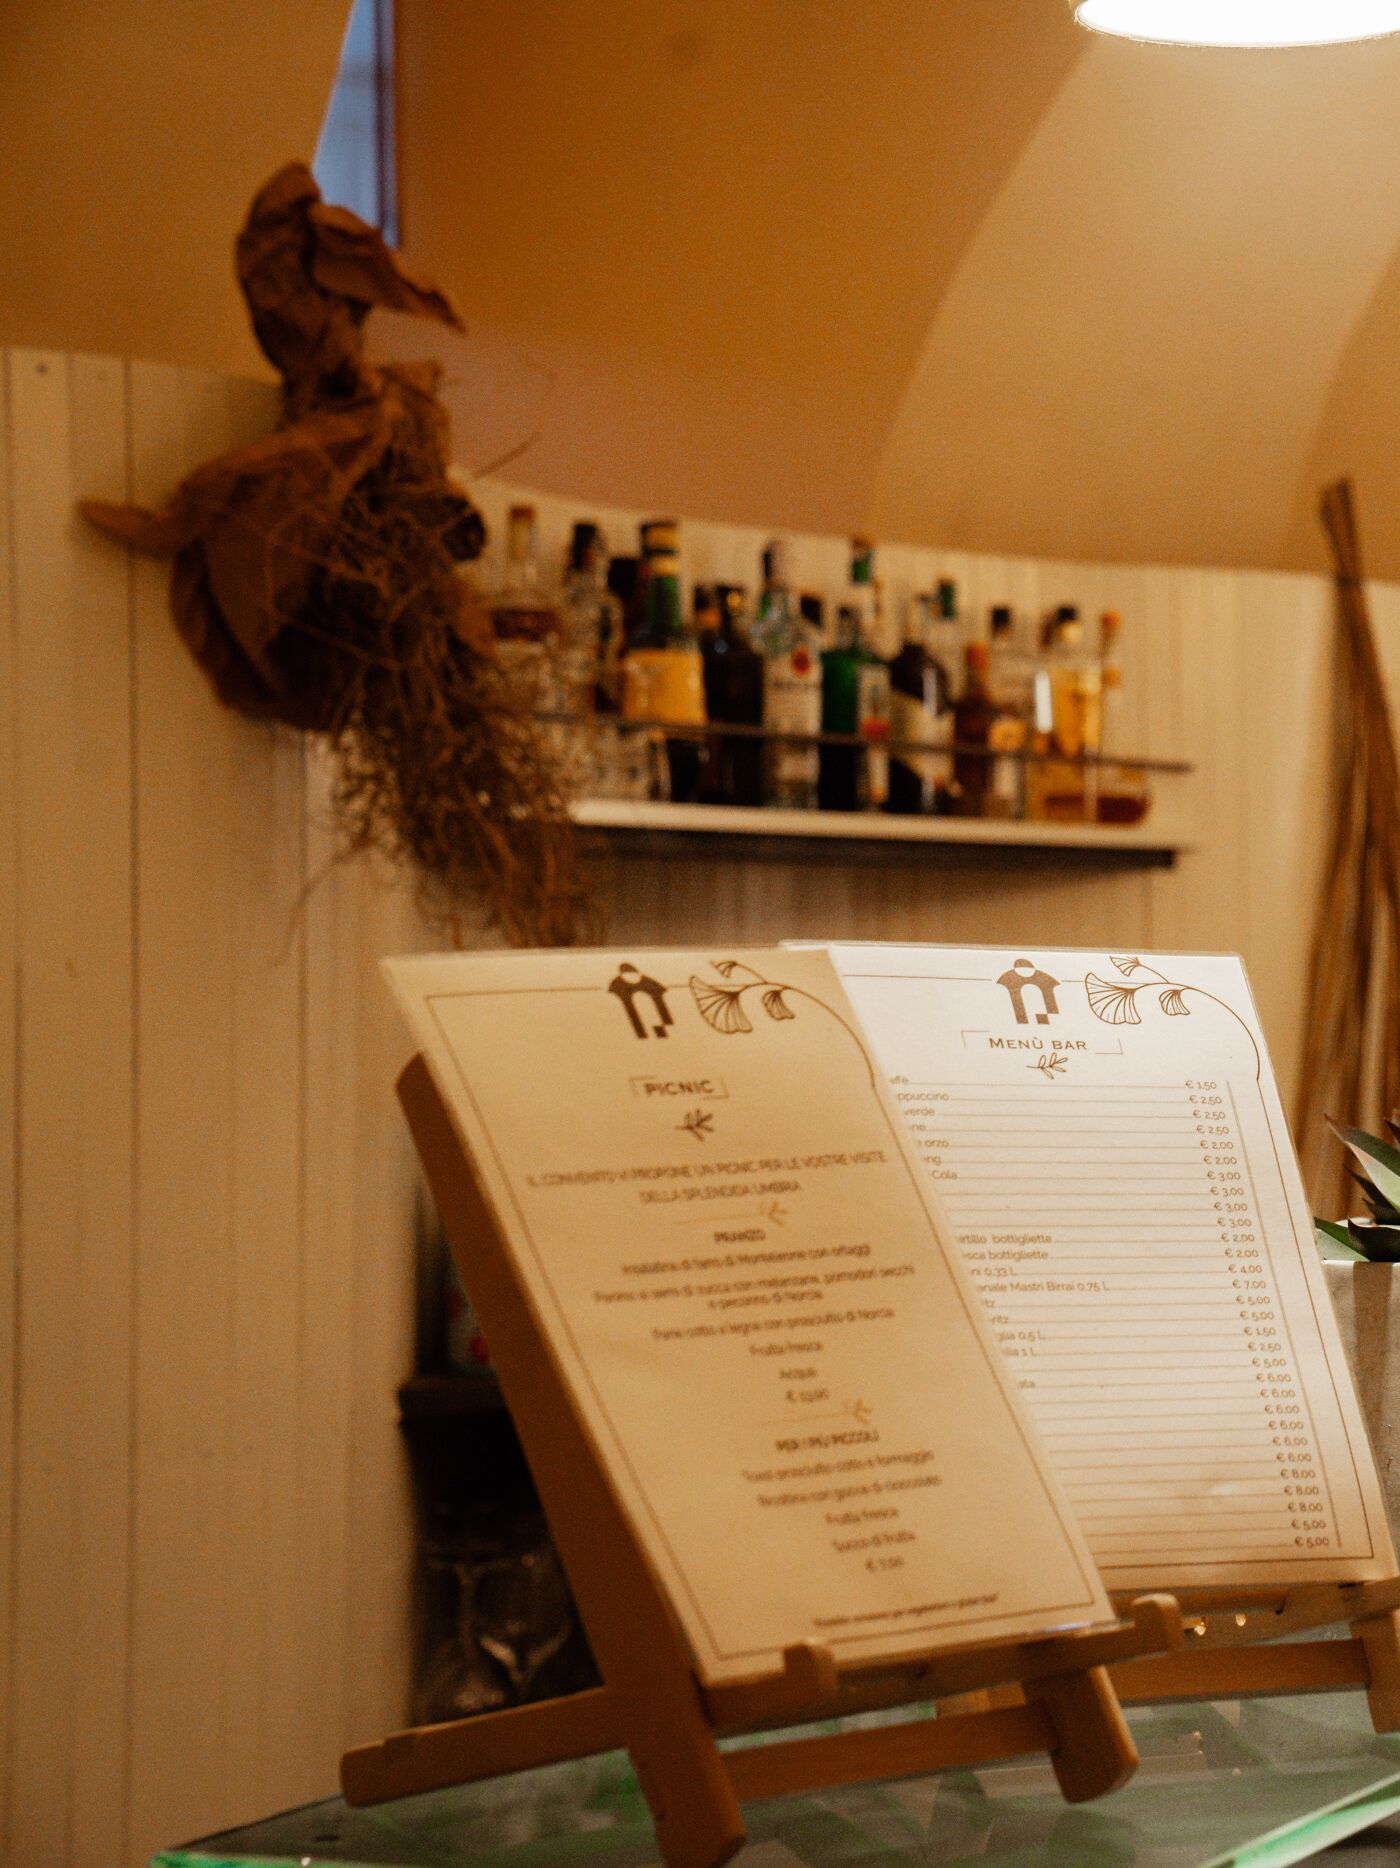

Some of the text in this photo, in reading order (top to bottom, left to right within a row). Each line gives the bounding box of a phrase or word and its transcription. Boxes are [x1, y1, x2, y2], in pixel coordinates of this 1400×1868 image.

[1052, 1040, 1087, 1050] BAR
[643, 1080, 715, 1097] PICNIC
[1185, 1080, 1193, 1088] €
[897, 1092, 950, 1102] ppuccino
[1190, 1095, 1197, 1103] €
[1193, 1110, 1201, 1118] €
[1196, 1125, 1205, 1133] €
[1200, 1140, 1208, 1149] €
[1204, 1155, 1212, 1164] €
[932, 1169, 957, 1179] Cola
[1207, 1171, 1215, 1180] €
[1211, 1186, 1219, 1195] €
[1214, 1202, 1222, 1211] €
[1218, 1217, 1225, 1226] €
[1221, 1233, 1229, 1242] €
[1225, 1248, 1233, 1257] €
[1228, 1264, 1237, 1273] €
[1232, 1279, 1240, 1288] €
[1236, 1295, 1245, 1304] €
[1240, 1311, 1248, 1319] €
[1244, 1327, 1252, 1336] €
[1248, 1341, 1256, 1351] €
[1252, 1357, 1260, 1366] €
[1256, 1373, 1264, 1382] €
[1260, 1389, 1269, 1398] €
[1264, 1404, 1273, 1414] €
[1268, 1420, 1277, 1430] €
[1273, 1436, 1281, 1446] €
[1276, 1453, 1285, 1462] €
[1280, 1468, 1288, 1478] €
[1284, 1485, 1292, 1495] €
[1288, 1502, 1296, 1512] €
[1291, 1519, 1300, 1529] €
[1295, 1536, 1303, 1546] €
